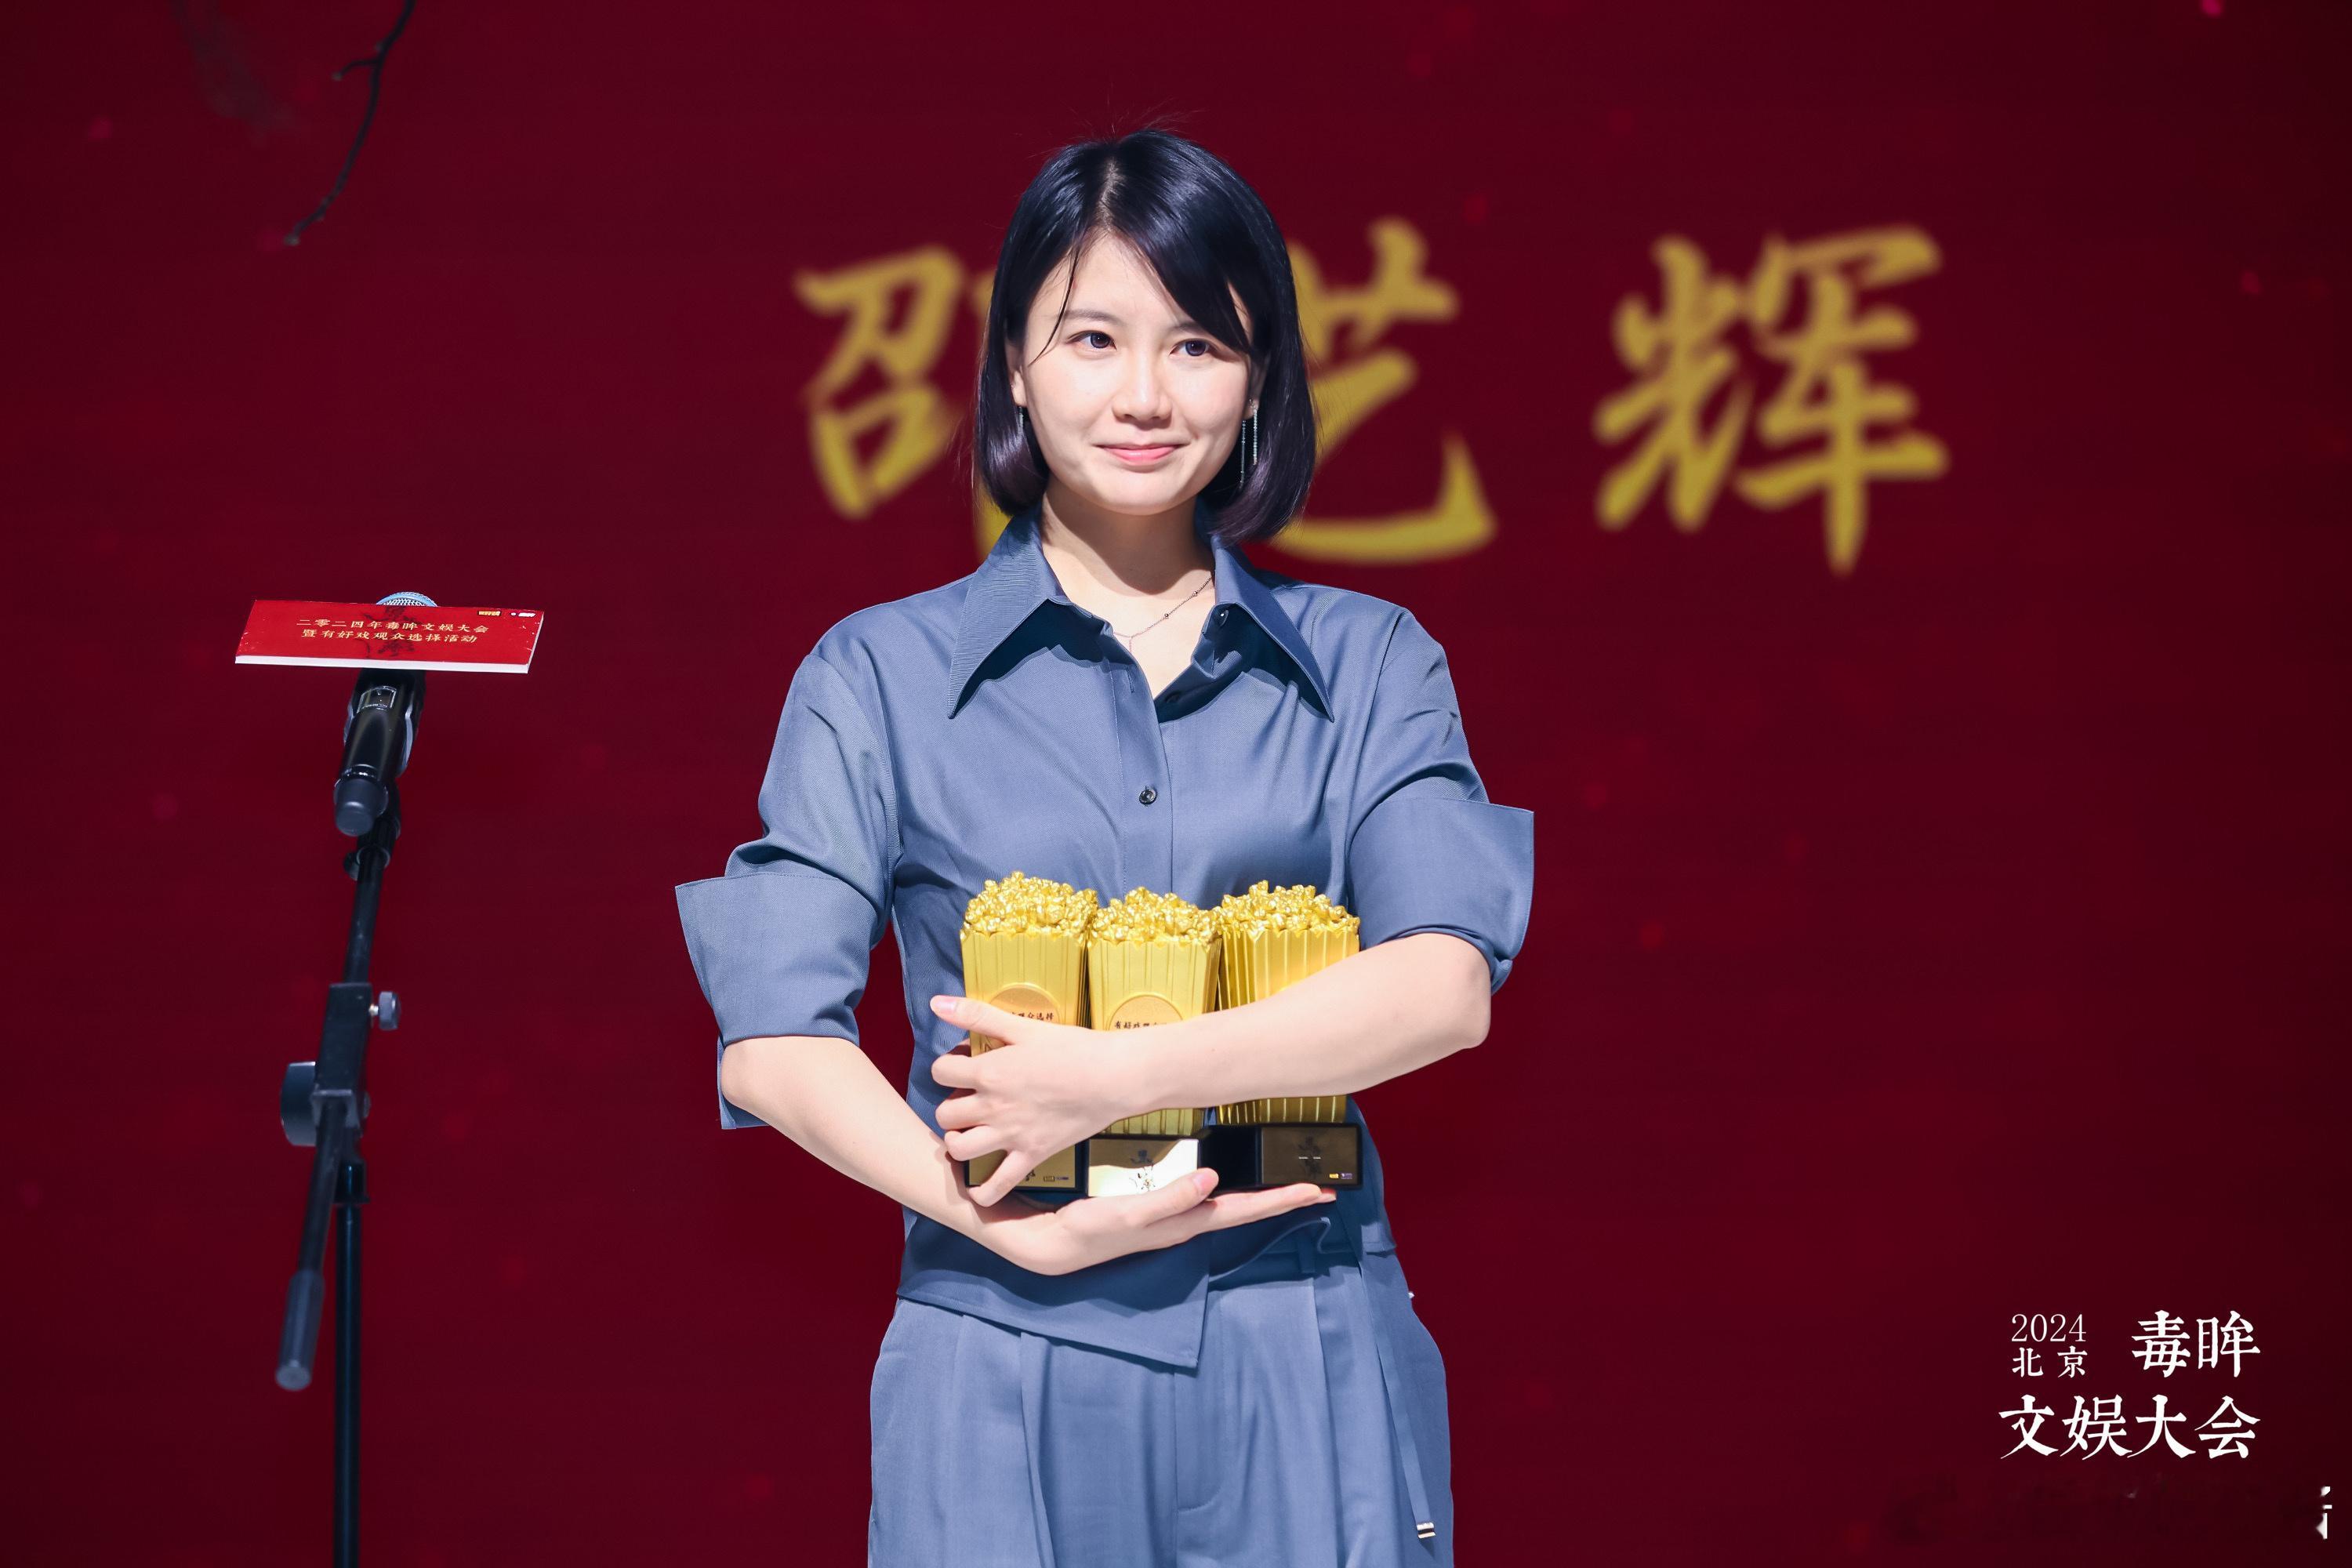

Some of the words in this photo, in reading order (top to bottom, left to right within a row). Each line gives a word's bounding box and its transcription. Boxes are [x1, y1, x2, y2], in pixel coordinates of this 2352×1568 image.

[797, 220, 1947, 573] 邵艺辉
[296, 619, 489, 633] 二零二四年毒眸文娱大会
[301, 629, 478, 643] 暨有好戏观众选择活动
